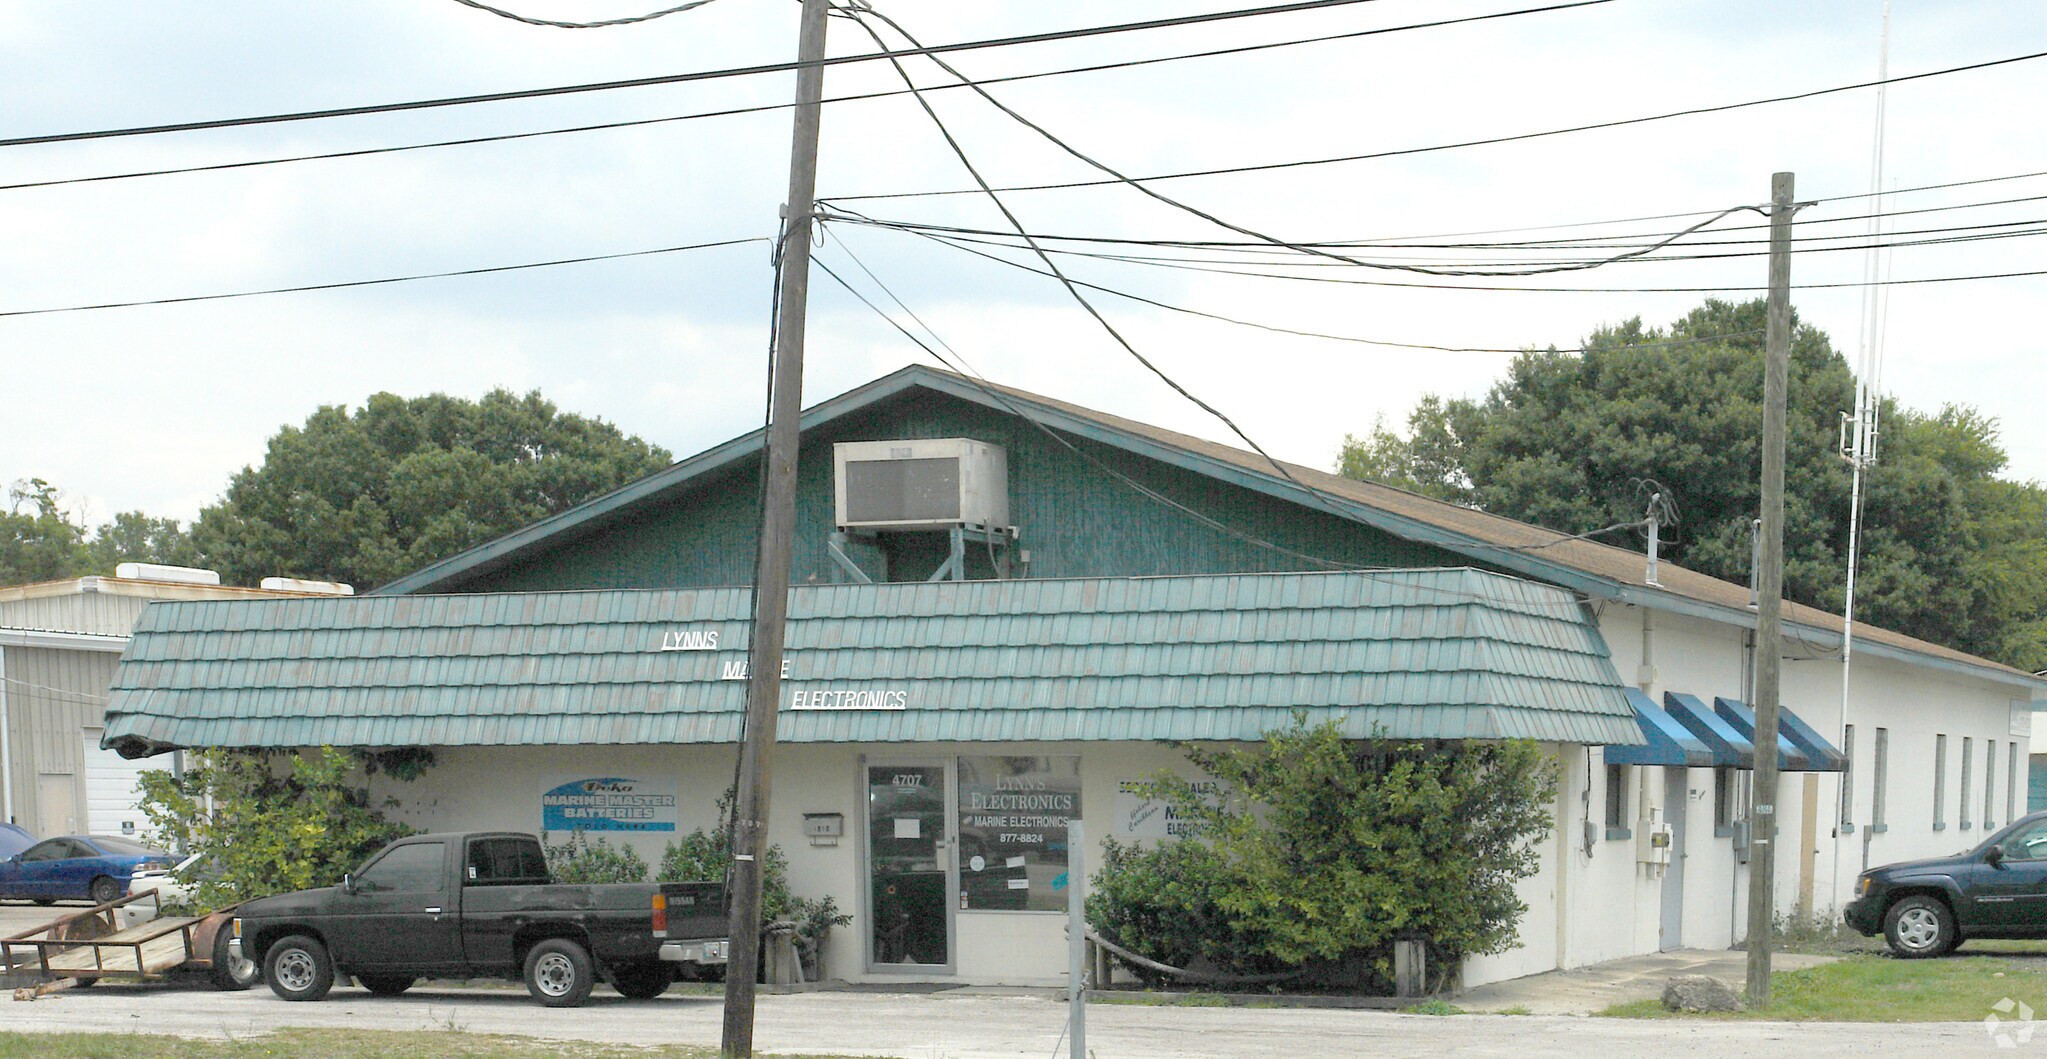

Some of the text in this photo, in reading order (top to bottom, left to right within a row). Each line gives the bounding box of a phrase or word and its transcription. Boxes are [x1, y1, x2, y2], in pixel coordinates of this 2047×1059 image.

[661, 631, 719, 651] LYNNS
[722, 660, 790, 680] MAE
[791, 690, 908, 710] ELECTRONICS
[892, 774, 923, 787] 4707
[543, 794, 676, 807] MARINE MASTER
[971, 793, 1072, 811] ELECTRONICS
[563, 807, 655, 819] BATTERIES
[974, 815, 1068, 828] MARINE ELECTRONICS
[1000, 833, 1043, 844] 877-8824
